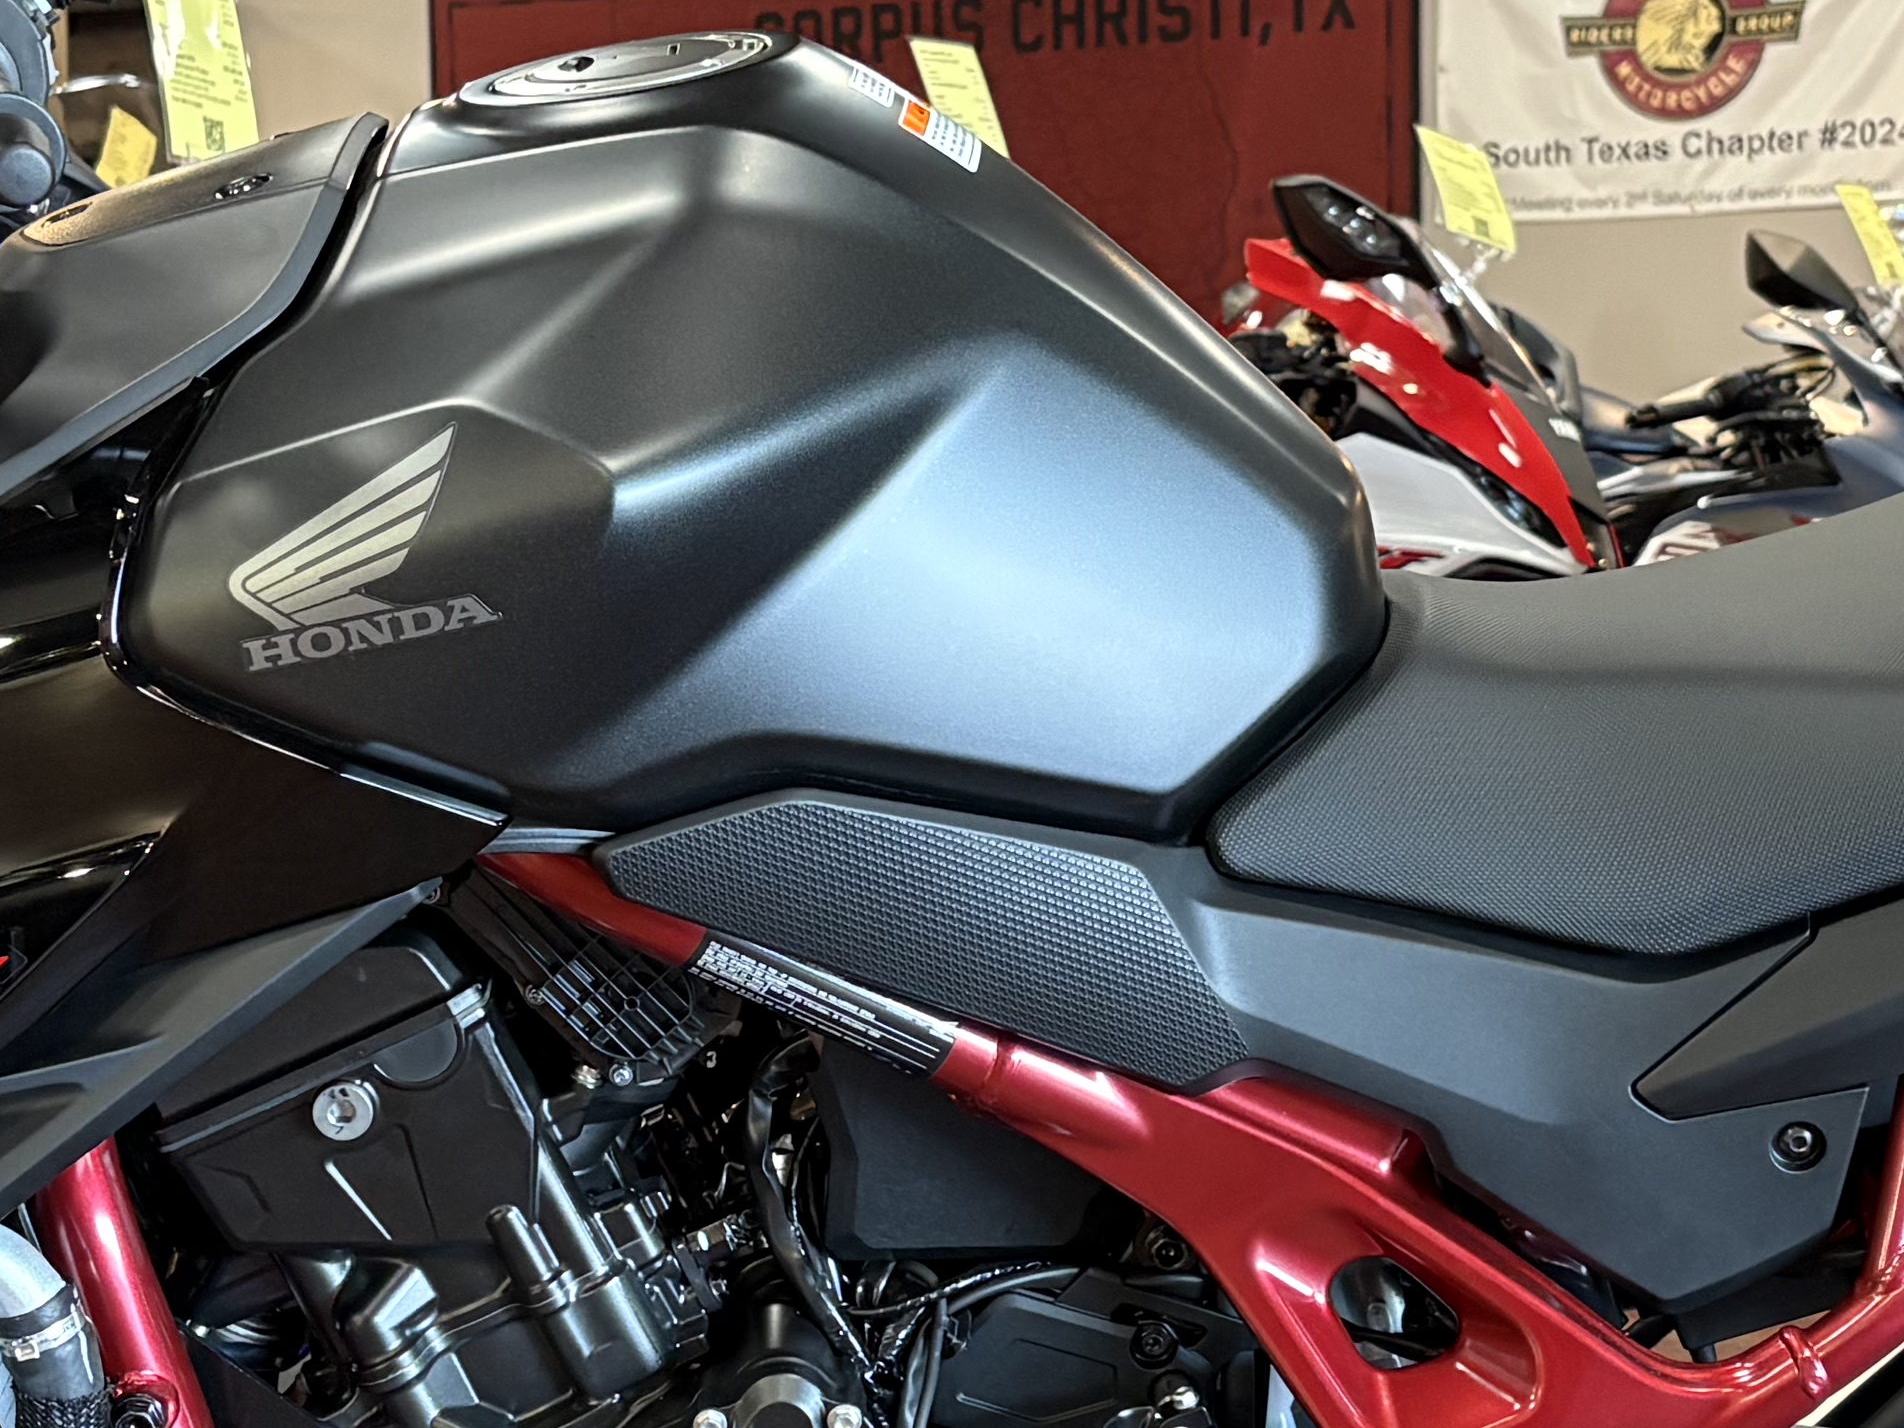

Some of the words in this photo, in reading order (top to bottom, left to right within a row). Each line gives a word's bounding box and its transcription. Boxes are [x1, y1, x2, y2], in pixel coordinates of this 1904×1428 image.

[1614, 54, 1748, 112] MOTORCYCLE
[1483, 141, 1572, 169] South
[1579, 133, 1669, 165] Texas
[1681, 126, 1809, 168] Chapter
[241, 594, 498, 672] HONDA
